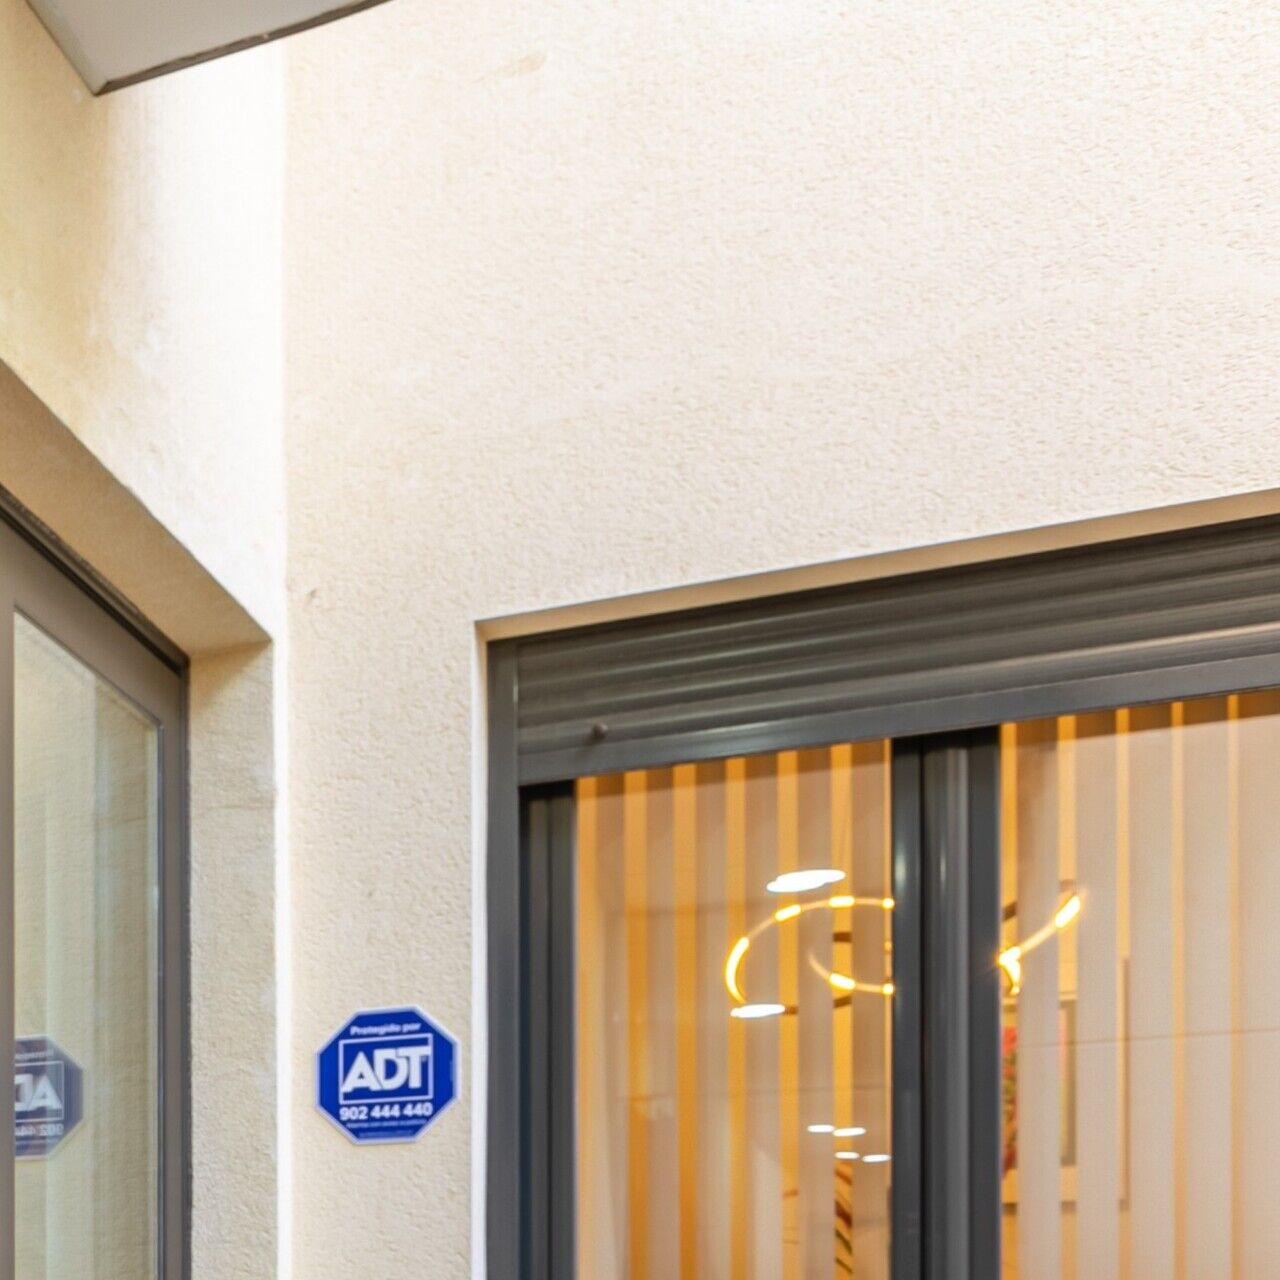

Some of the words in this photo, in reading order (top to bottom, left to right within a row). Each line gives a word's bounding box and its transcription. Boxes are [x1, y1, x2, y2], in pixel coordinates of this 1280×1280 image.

[349, 1023, 401, 1036] Protegido
[402, 1022, 422, 1034] por
[341, 1046, 432, 1093] ADT
[339, 1106, 369, 1121] 902
[370, 1104, 401, 1119] 444
[402, 1102, 434, 1117] 440
